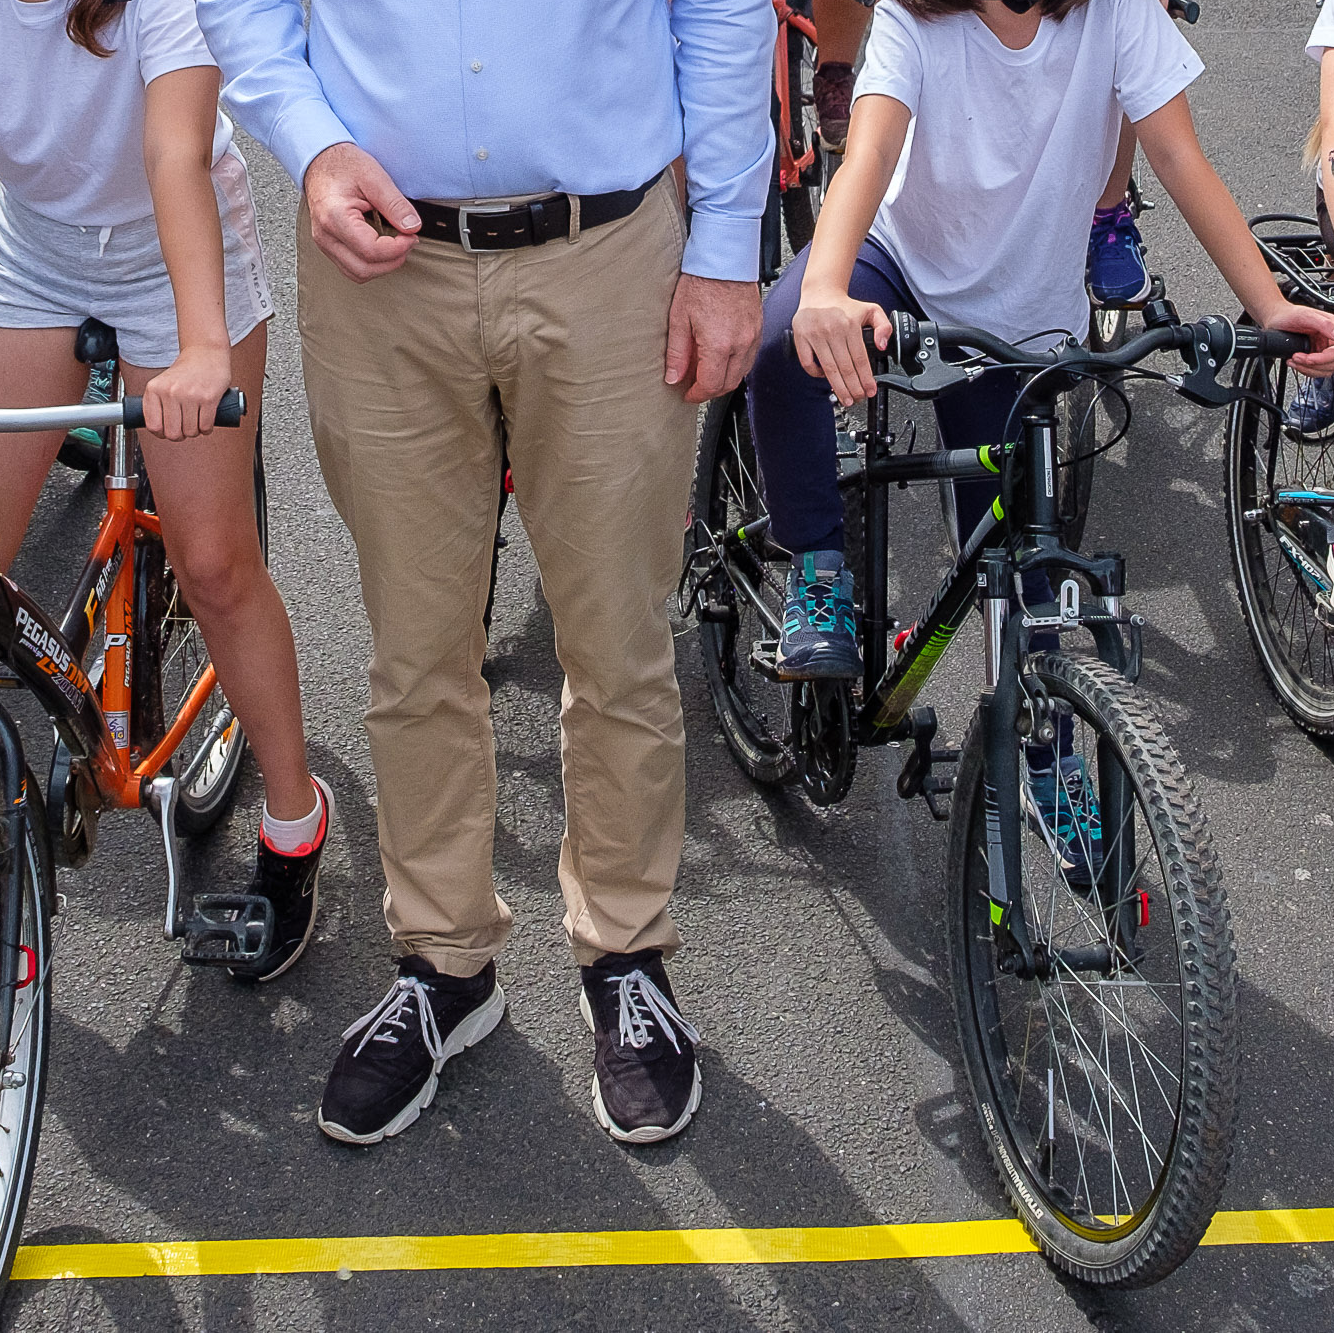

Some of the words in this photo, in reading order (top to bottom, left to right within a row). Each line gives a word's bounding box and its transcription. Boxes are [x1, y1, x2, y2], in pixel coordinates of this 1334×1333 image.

[250, 262, 267, 310] AHEAD
[16, 606, 71, 672] PEGASUS
[124, 640, 132, 688] PEGASUS
